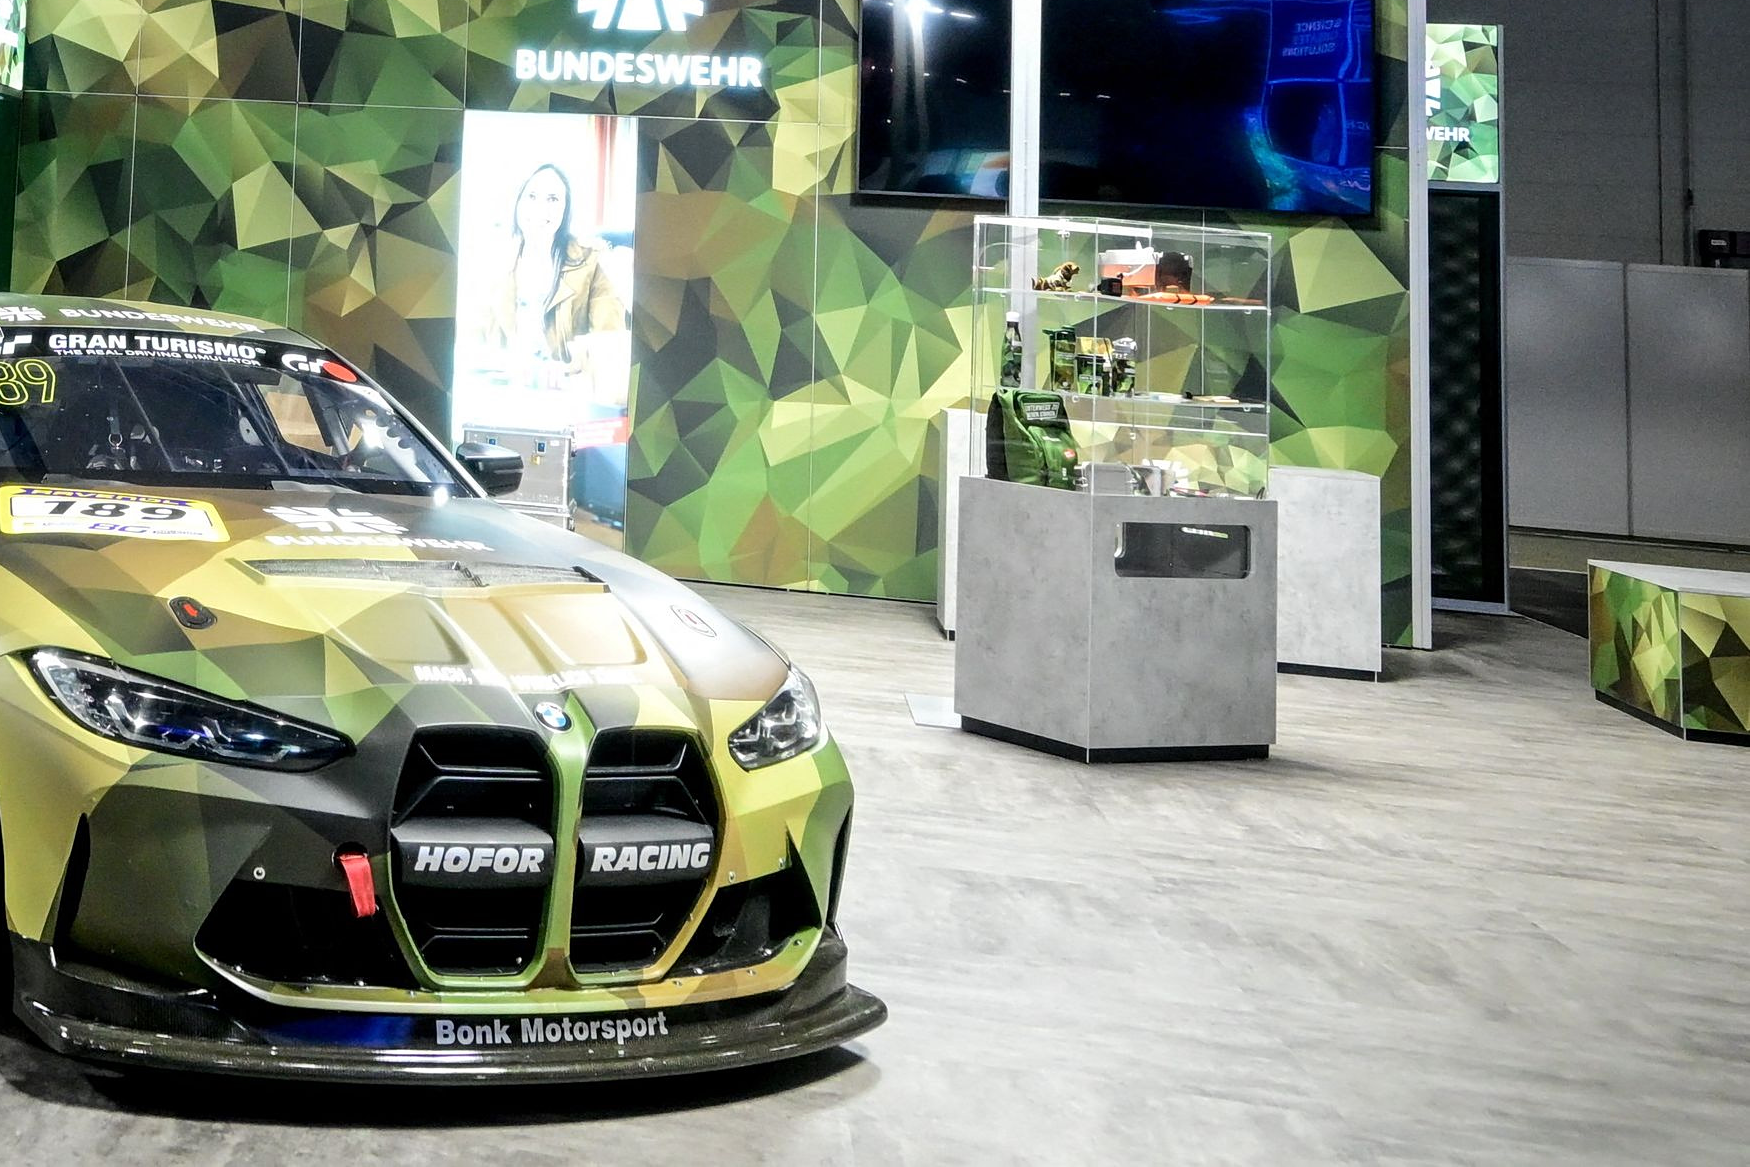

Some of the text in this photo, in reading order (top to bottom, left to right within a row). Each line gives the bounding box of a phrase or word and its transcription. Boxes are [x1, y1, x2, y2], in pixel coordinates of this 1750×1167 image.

[514, 48, 763, 87] BUNDESWEHR
[59, 308, 265, 333] BUNDESWEHR
[48, 334, 127, 350] GRAN
[87, 349, 124, 357] REAL
[125, 350, 182, 359] DRIVING
[184, 353, 261, 366] SIMULATOR
[30, 489, 184, 506] RAVENOL
[44, 500, 187, 521] 189
[264, 535, 495, 552] BUNDESWEHR
[414, 842, 710, 874] HOFOR RACING
[435, 1011, 669, 1045] Bonk Motorsport
